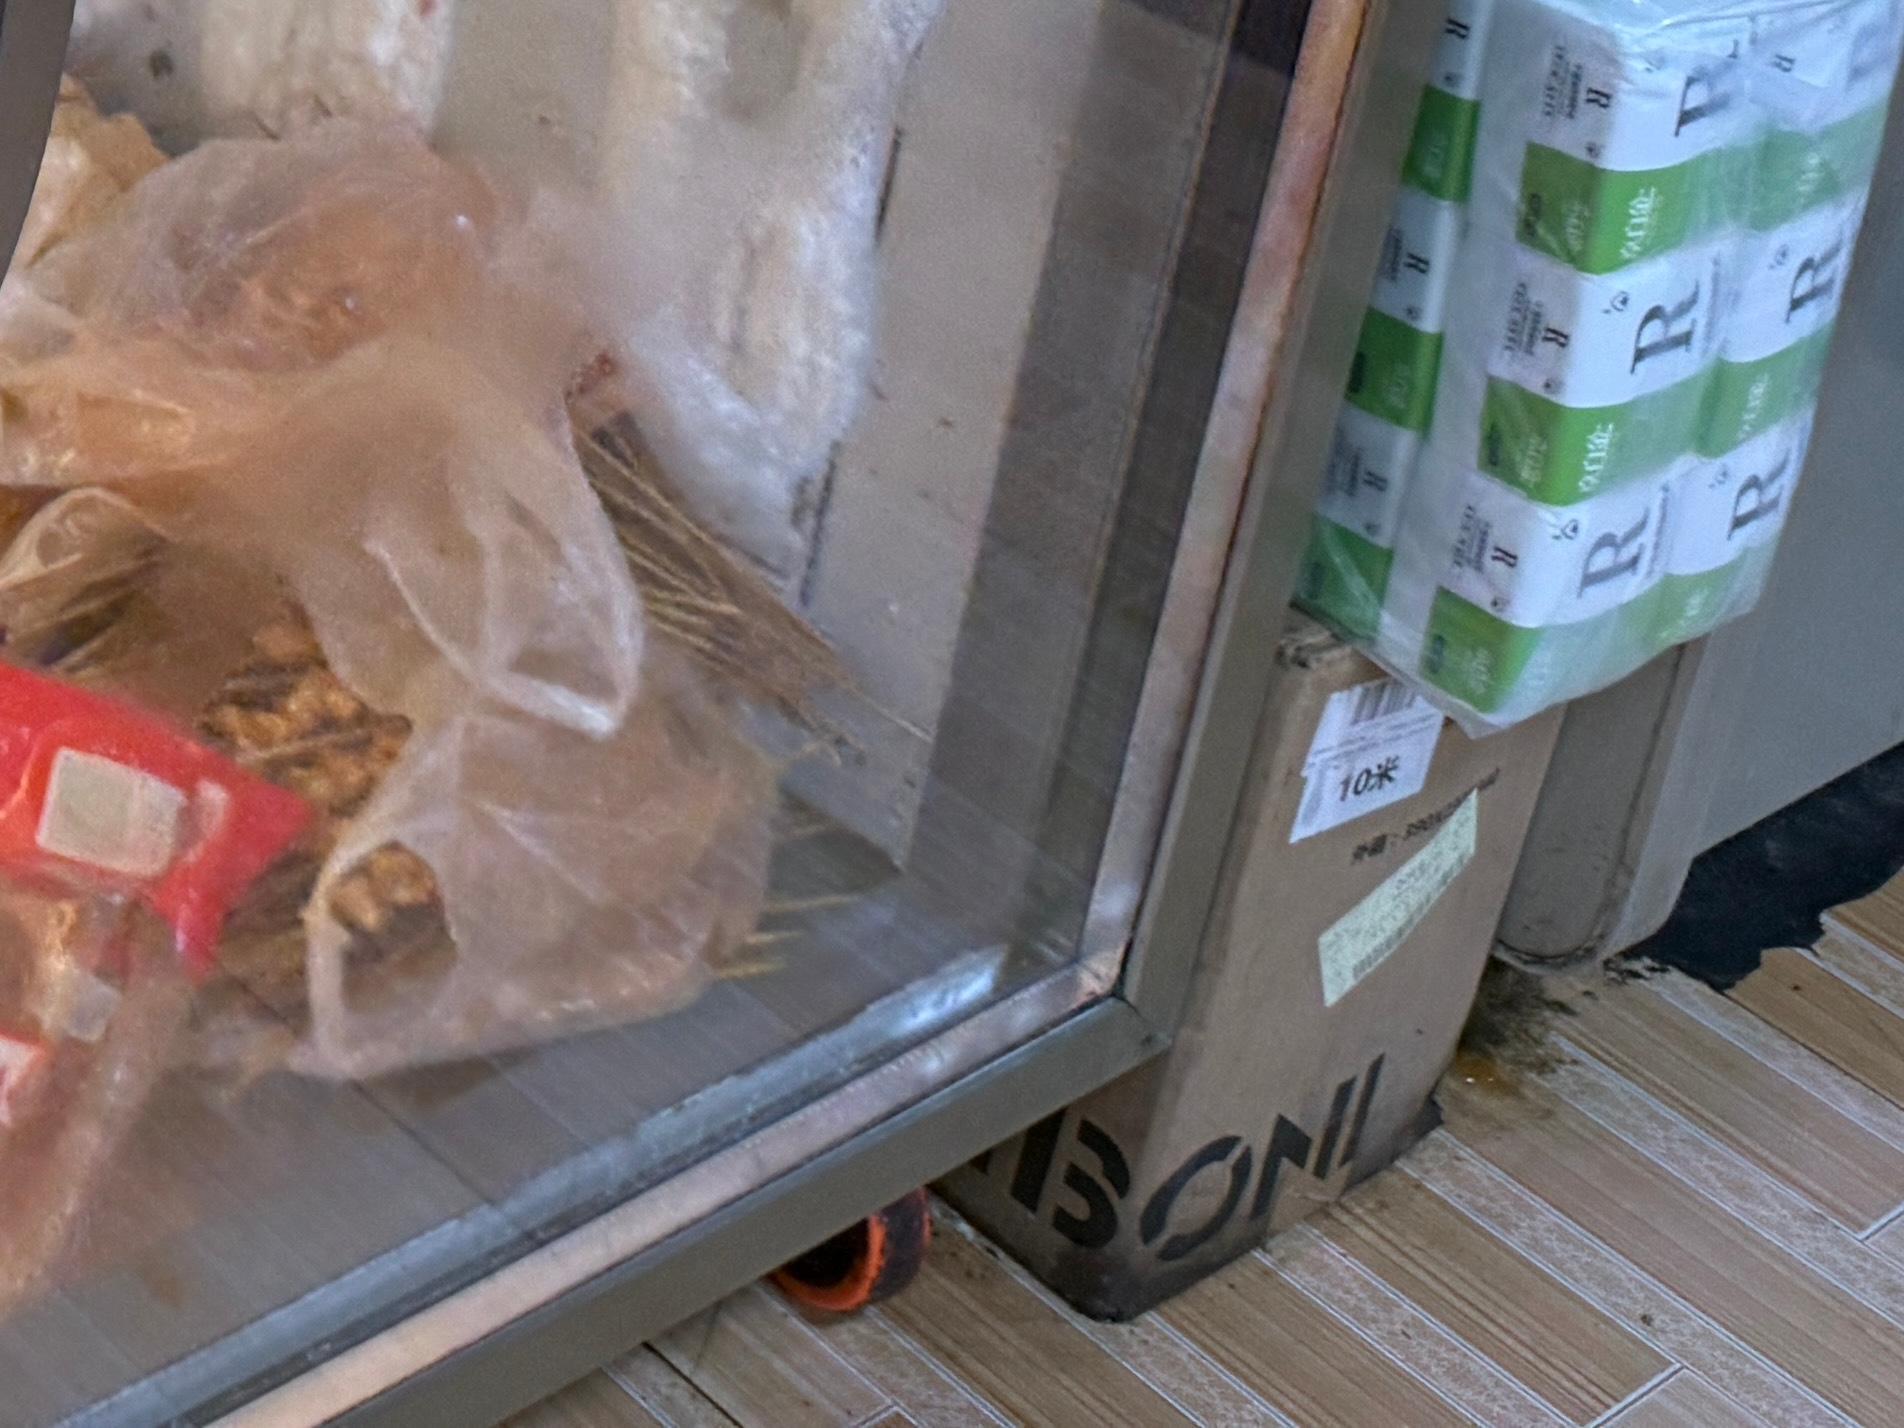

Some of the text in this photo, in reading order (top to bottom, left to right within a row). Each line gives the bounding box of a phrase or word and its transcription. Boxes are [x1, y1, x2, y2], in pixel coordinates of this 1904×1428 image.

[1629, 280, 1700, 374] R
[1786, 238, 1844, 324] R
[1726, 447, 1791, 541] R
[1576, 505, 1652, 600] R
[1337, 754, 1401, 804] 10米
